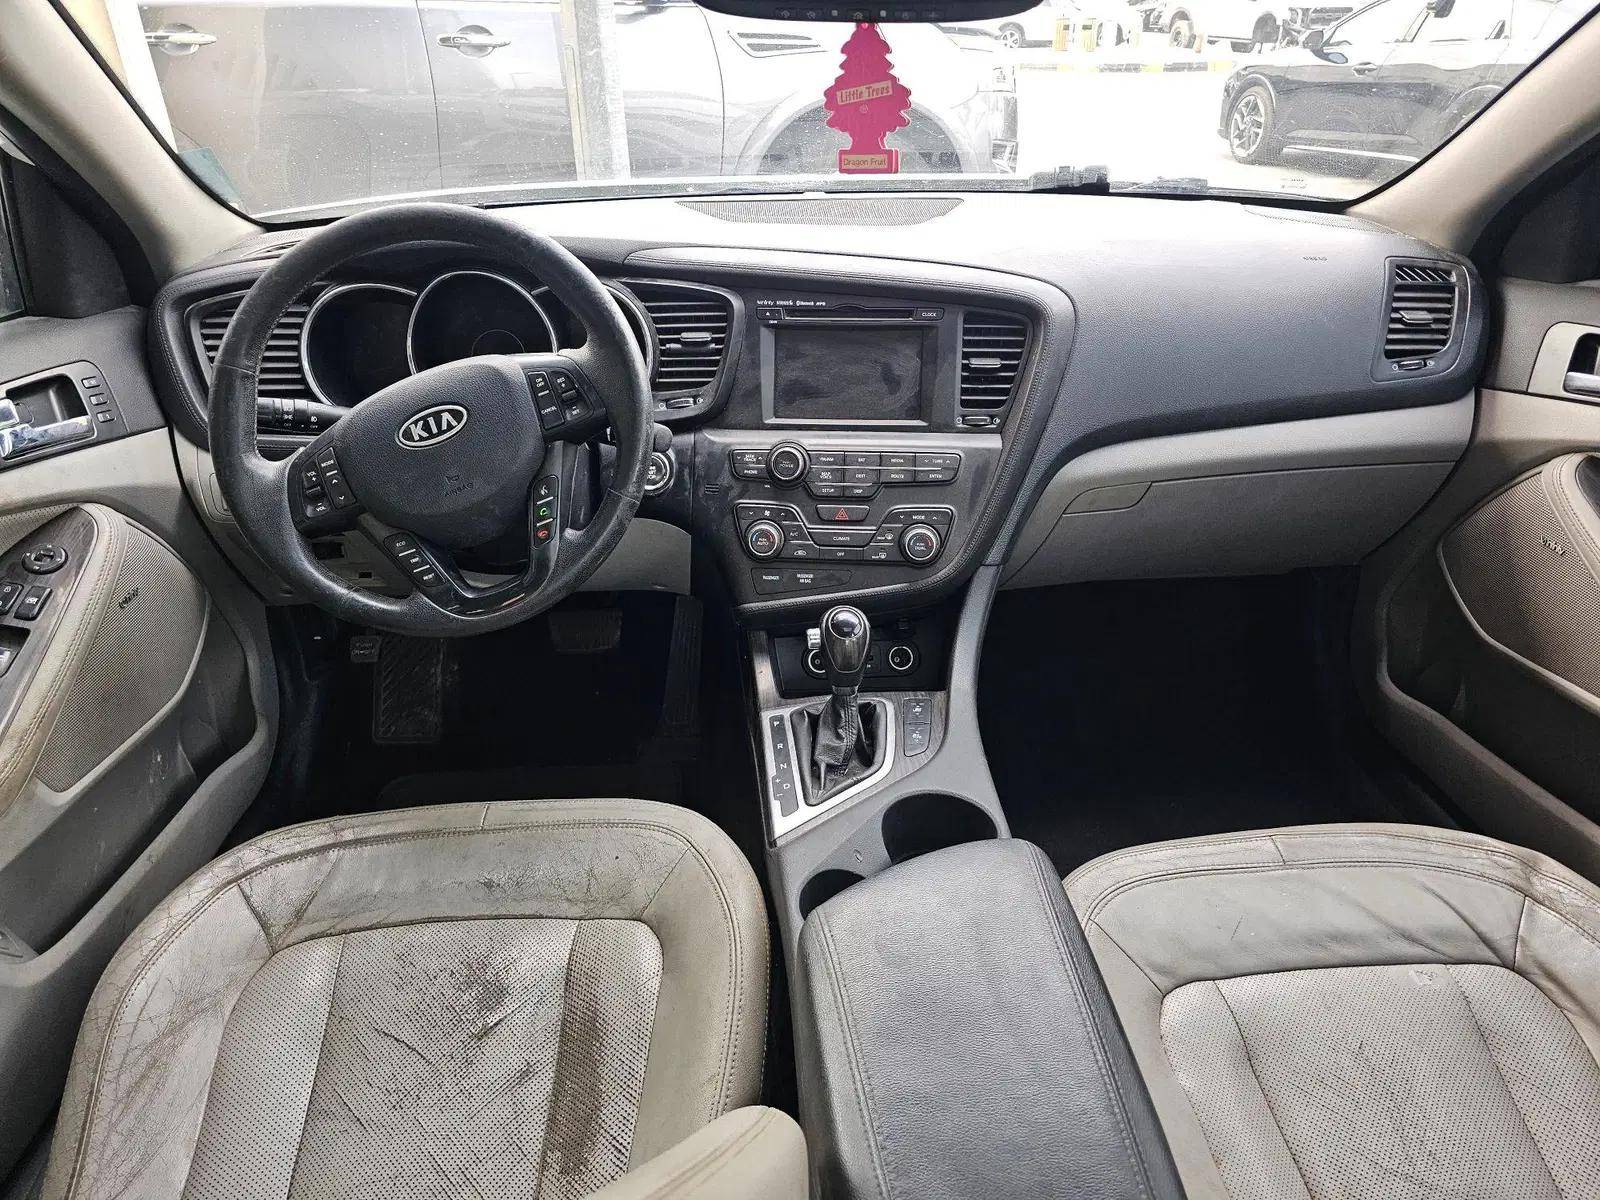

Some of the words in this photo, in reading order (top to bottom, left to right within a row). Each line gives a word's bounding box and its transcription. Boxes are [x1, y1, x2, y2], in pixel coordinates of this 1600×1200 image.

[840, 89, 864, 103] Little
[864, 85, 890, 97] Trees
[843, 158, 869, 168] Dragon
[870, 157, 887, 166] Fruit
[541, 405, 558, 415] CANCEL
[408, 411, 459, 442] KIA
[780, 762, 787, 770] N
